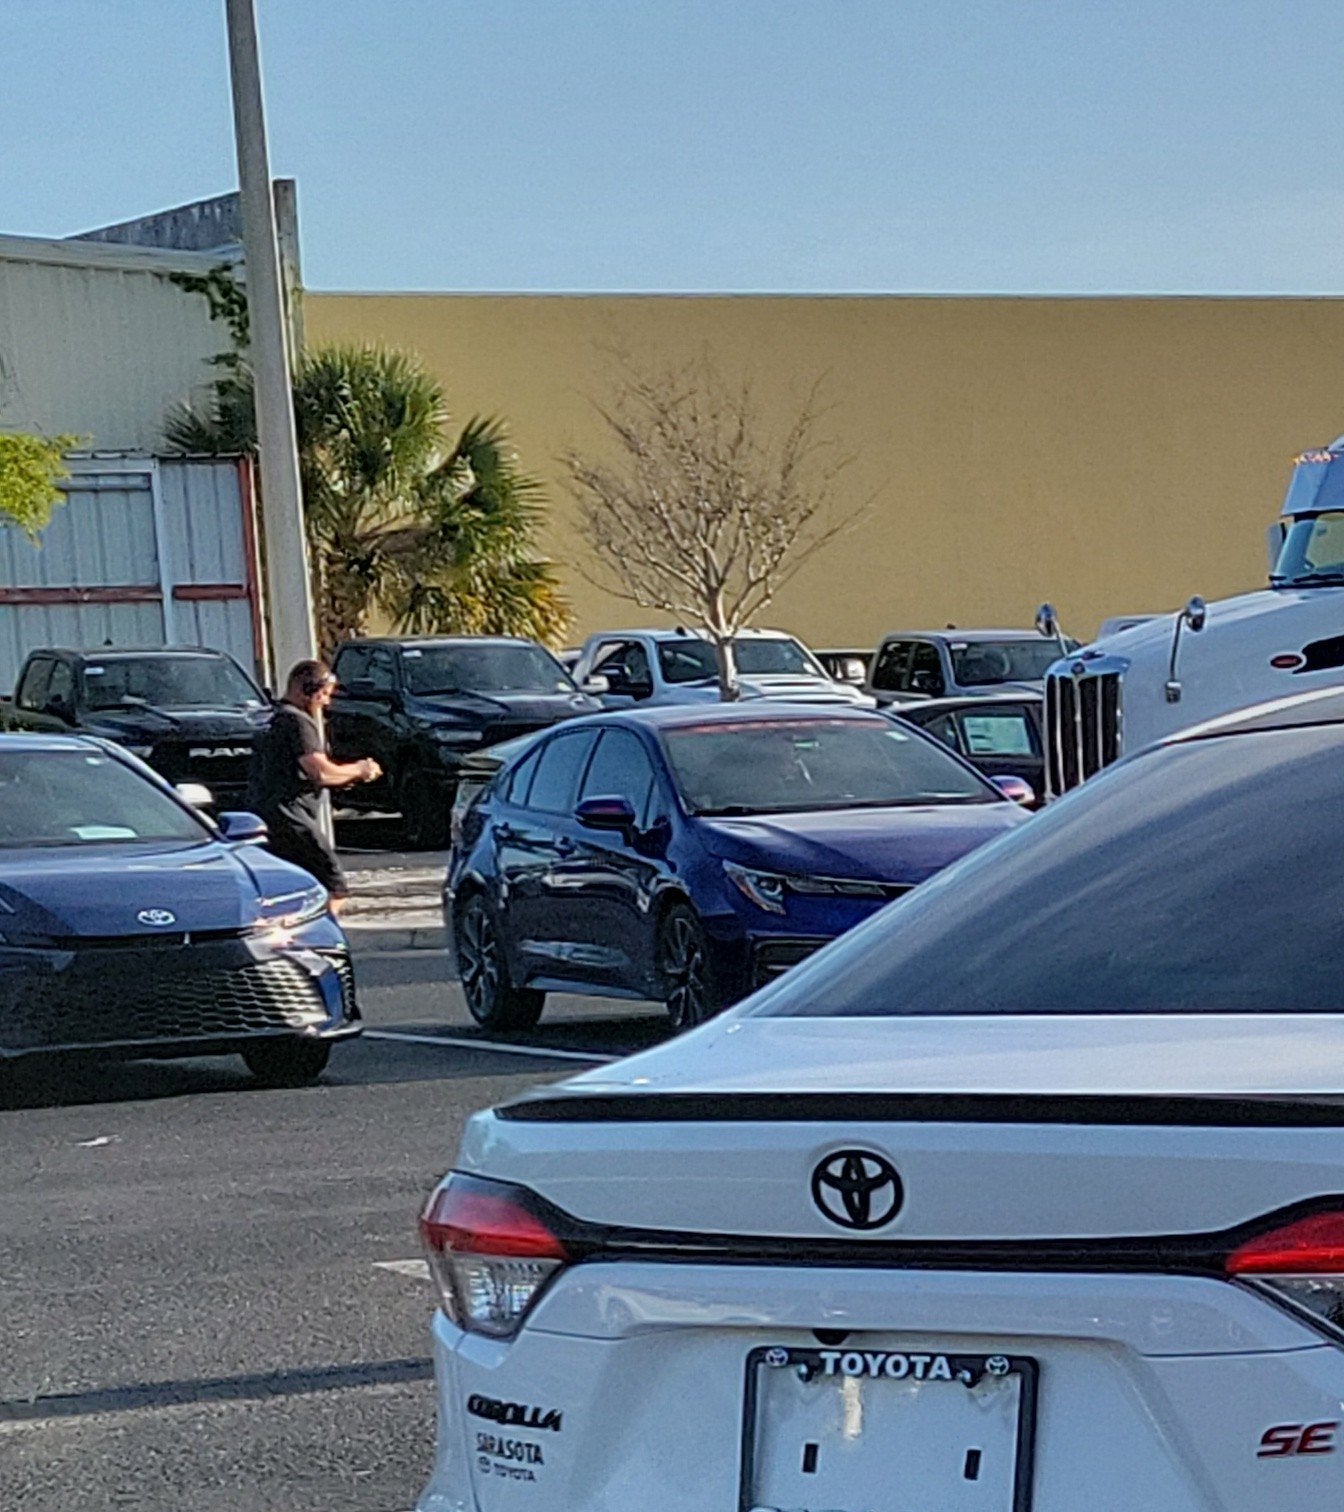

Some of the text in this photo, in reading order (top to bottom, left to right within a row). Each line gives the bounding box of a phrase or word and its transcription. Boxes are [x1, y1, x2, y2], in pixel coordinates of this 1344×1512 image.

[820, 1351, 952, 1380] TOYOTA
[467, 1393, 563, 1432] COROLLA
[476, 1432, 545, 1466] SARASOTA
[1257, 1421, 1341, 1458] SE
